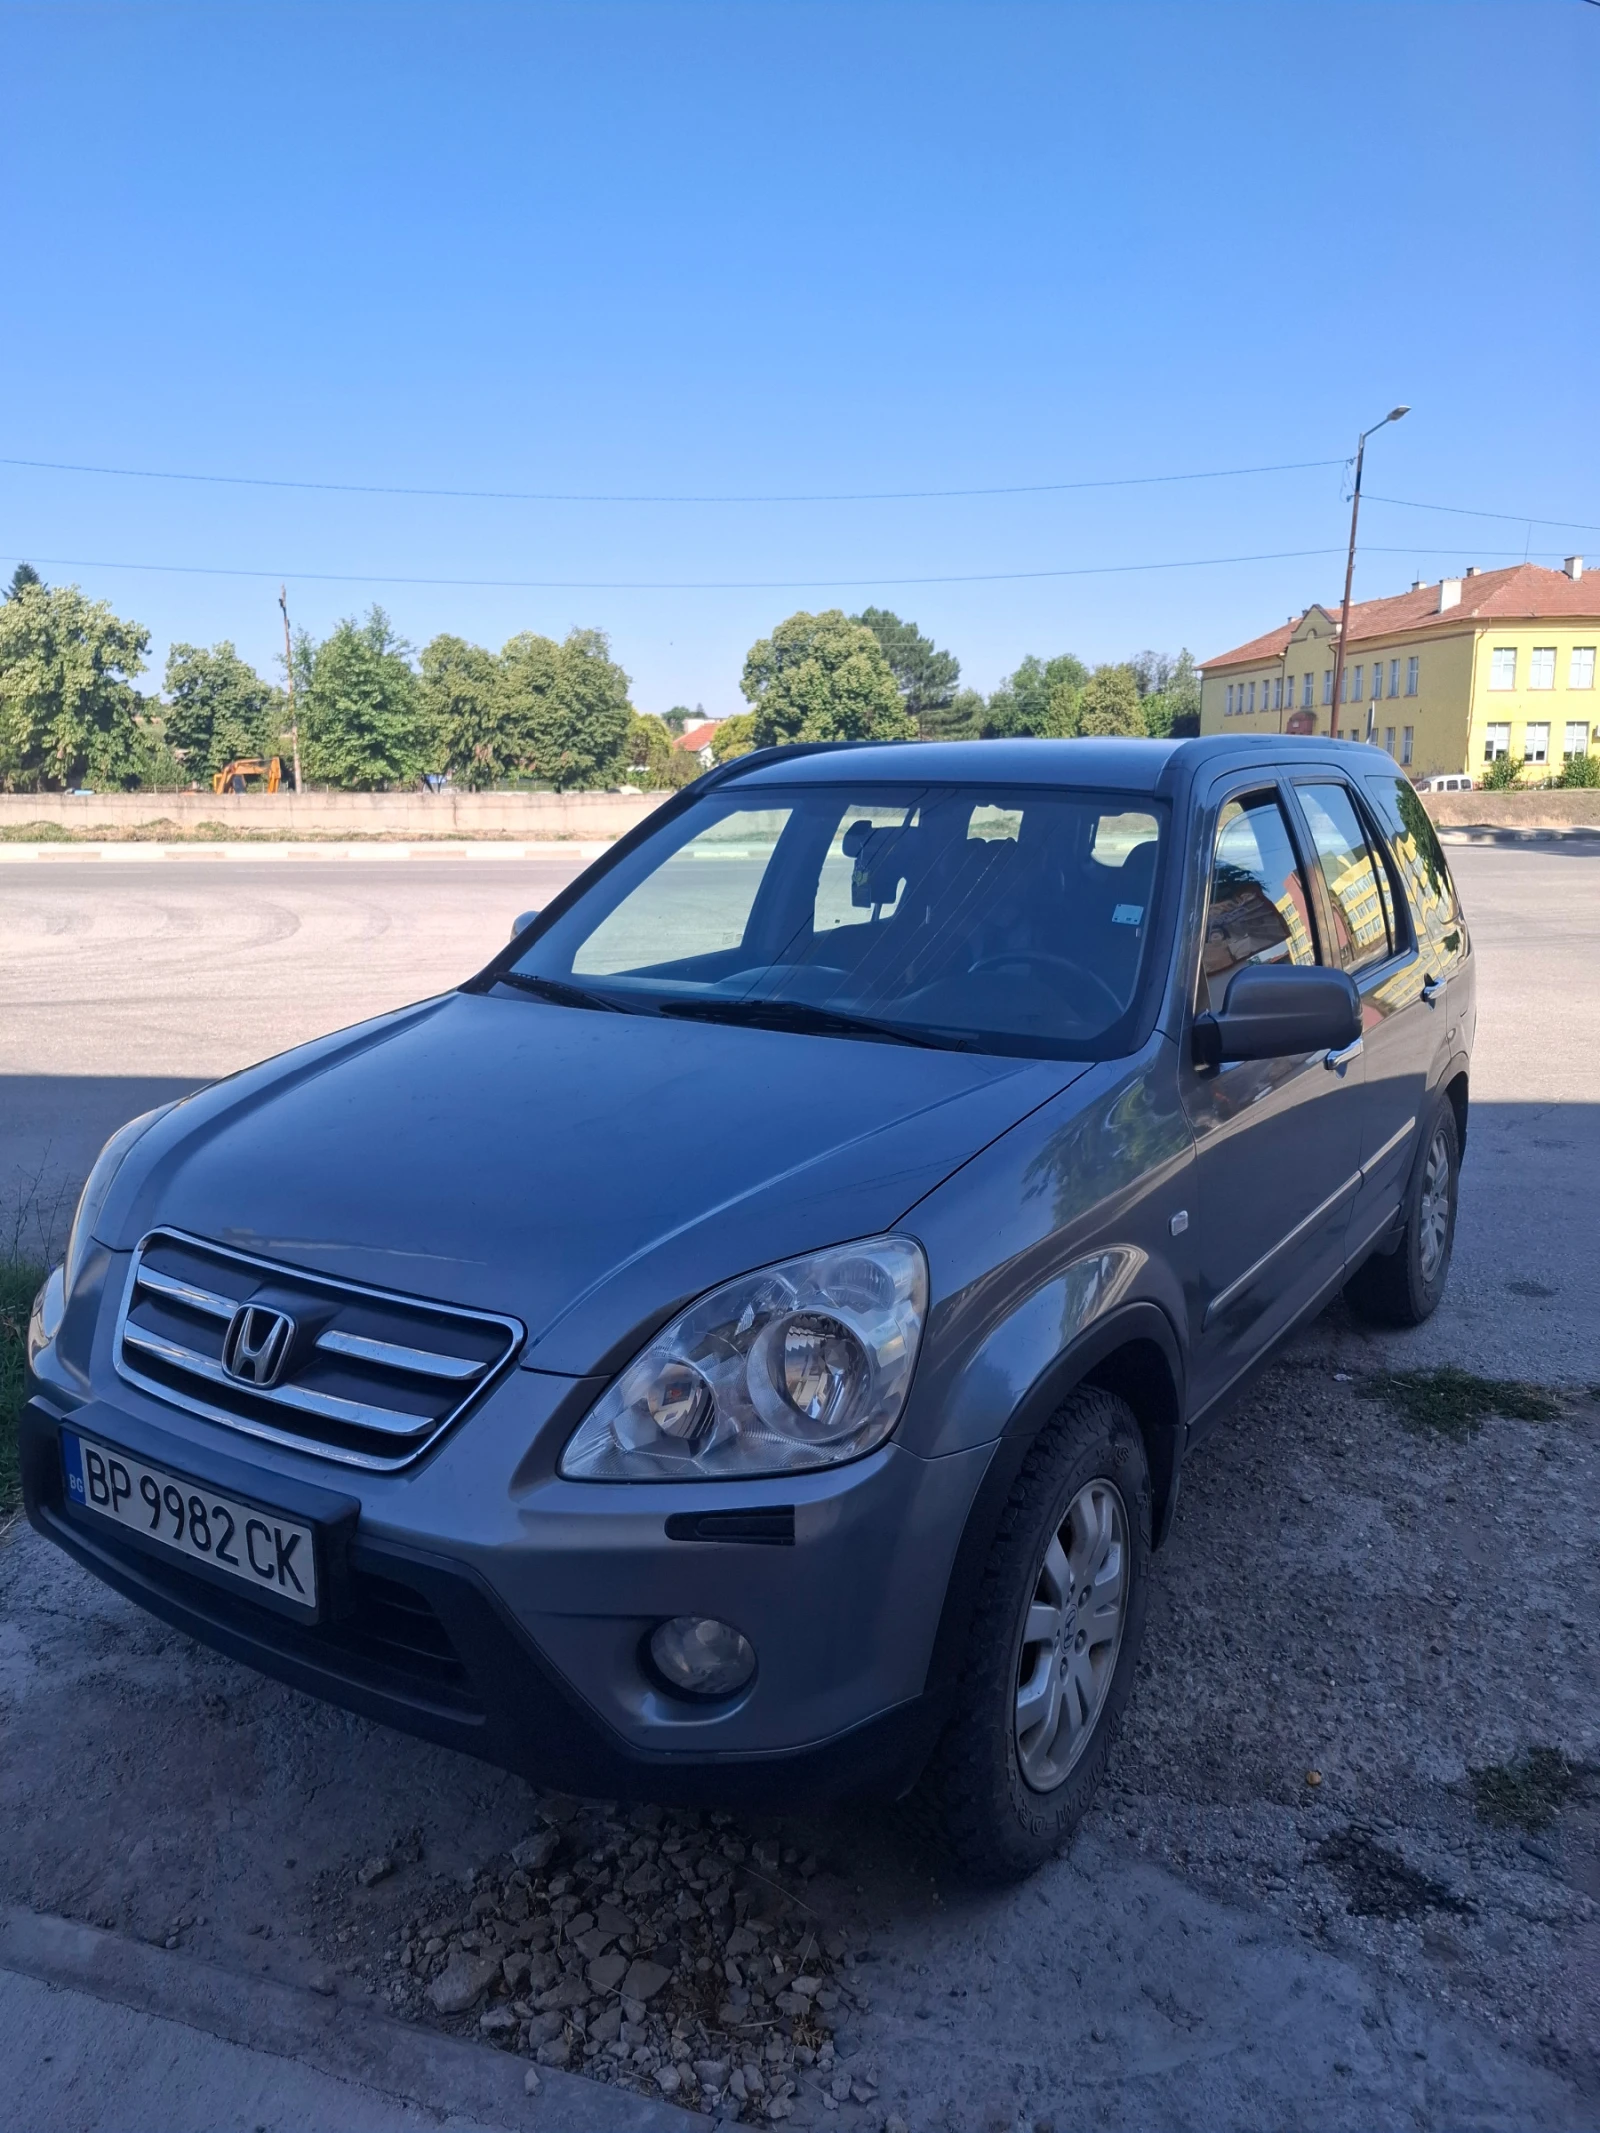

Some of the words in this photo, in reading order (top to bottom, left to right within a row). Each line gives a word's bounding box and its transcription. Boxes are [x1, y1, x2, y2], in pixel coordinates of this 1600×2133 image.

[69, 1474, 83, 1494] BG
[85, 1448, 131, 1513] BP
[140, 1475, 240, 1568] 9982
[245, 1518, 305, 1594] CK
